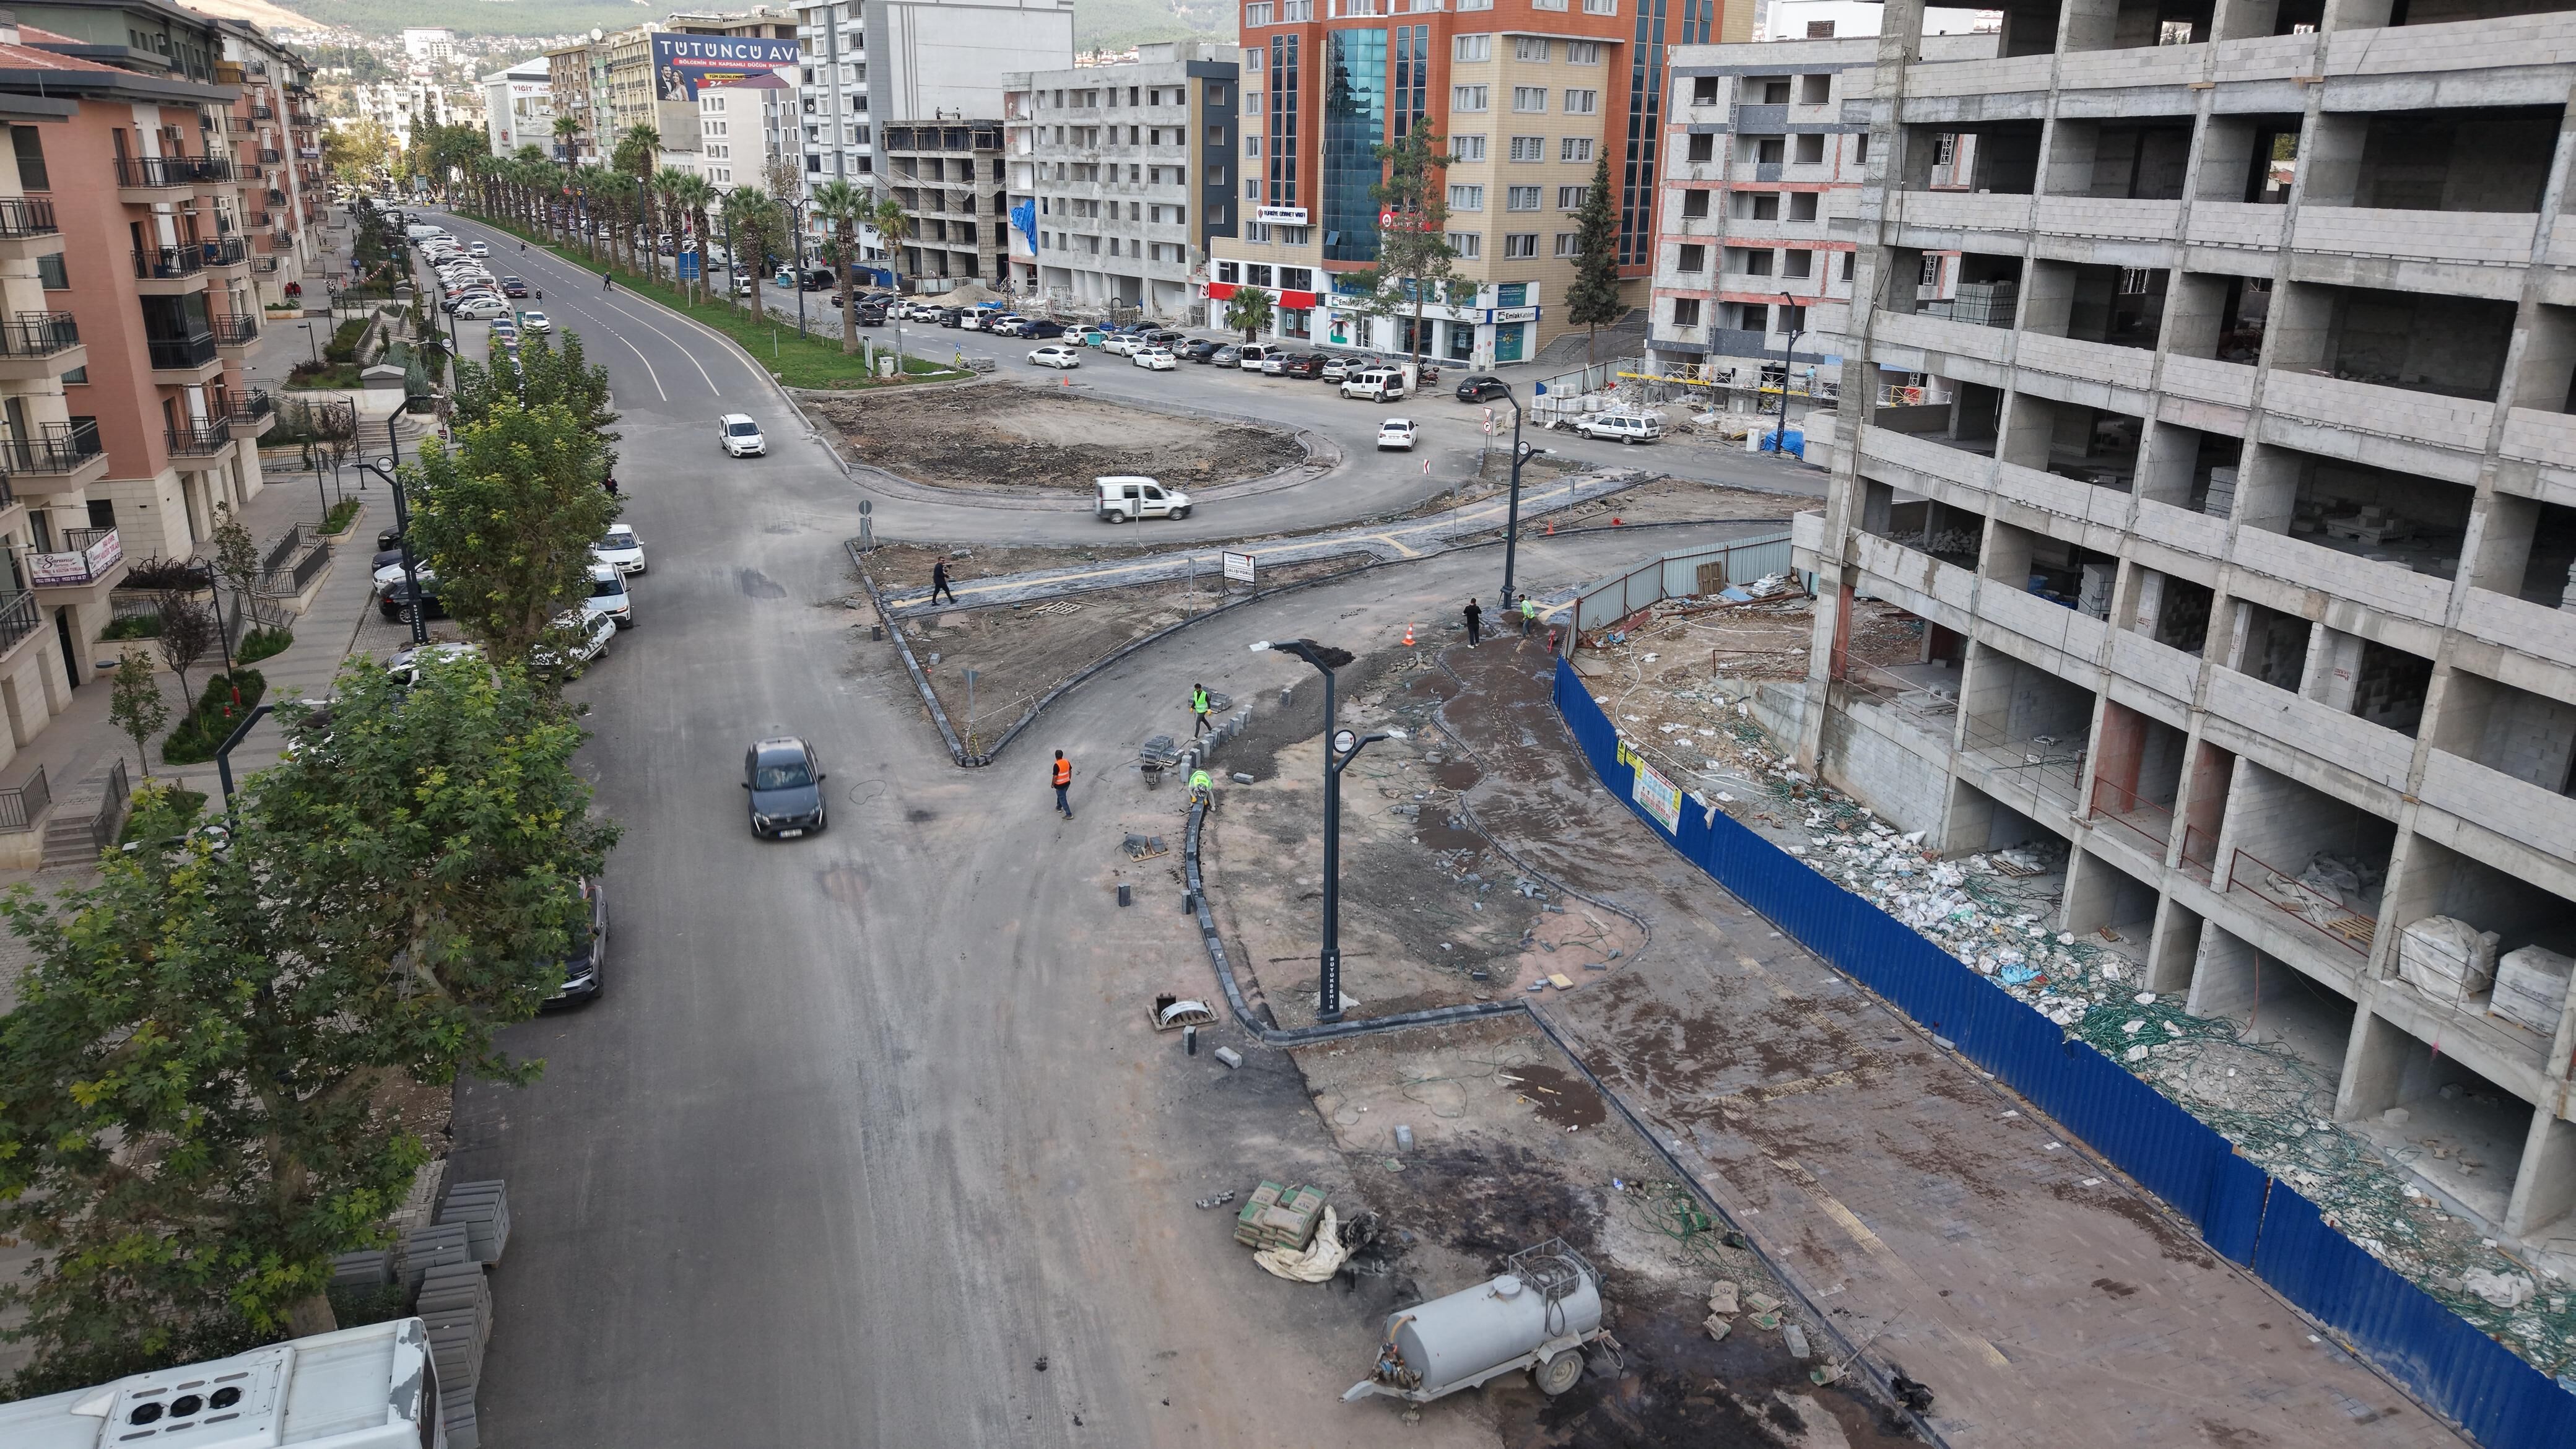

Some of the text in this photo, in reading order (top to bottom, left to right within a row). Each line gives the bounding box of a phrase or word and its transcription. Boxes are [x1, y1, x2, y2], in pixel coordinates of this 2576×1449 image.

[660, 40, 762, 59] TÜTÜNCÜ
[42, 555, 74, 569] Saranur
[1225, 568, 1254, 577] ÇALIŞIYORUZ
